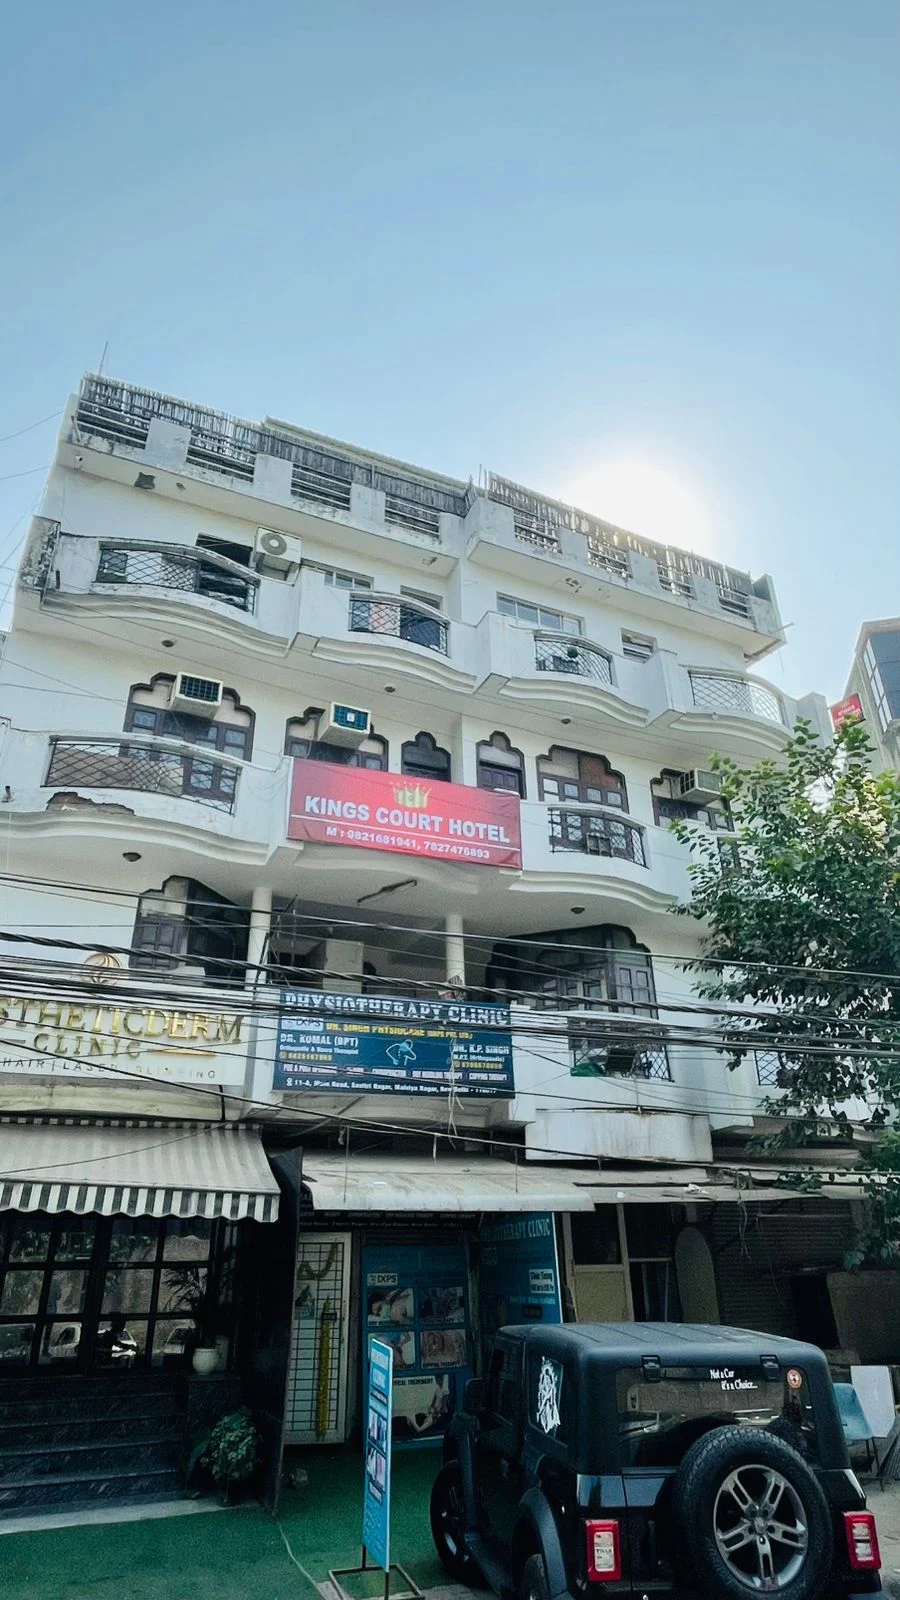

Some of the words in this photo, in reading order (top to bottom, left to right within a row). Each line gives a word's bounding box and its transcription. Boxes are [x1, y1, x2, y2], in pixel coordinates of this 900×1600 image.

[304, 796, 370, 822] KINGS
[375, 807, 443, 833] COURT
[448, 820, 511, 844] HOTEL
[284, 993, 443, 1020] PHYSIOTHERAPY
[448, 1006, 508, 1025] CLINIC
[280, 1033, 296, 1043] DR.
[299, 1034, 332, 1045] KOMAL
[33, 1033, 142, 1060] CLINIC
[485, 1045, 510, 1054] SINGH
[2, 1057, 46, 1071] HAIR
[709, 1369, 720, 1379] Not
[724, 1368, 734, 1378] Car
